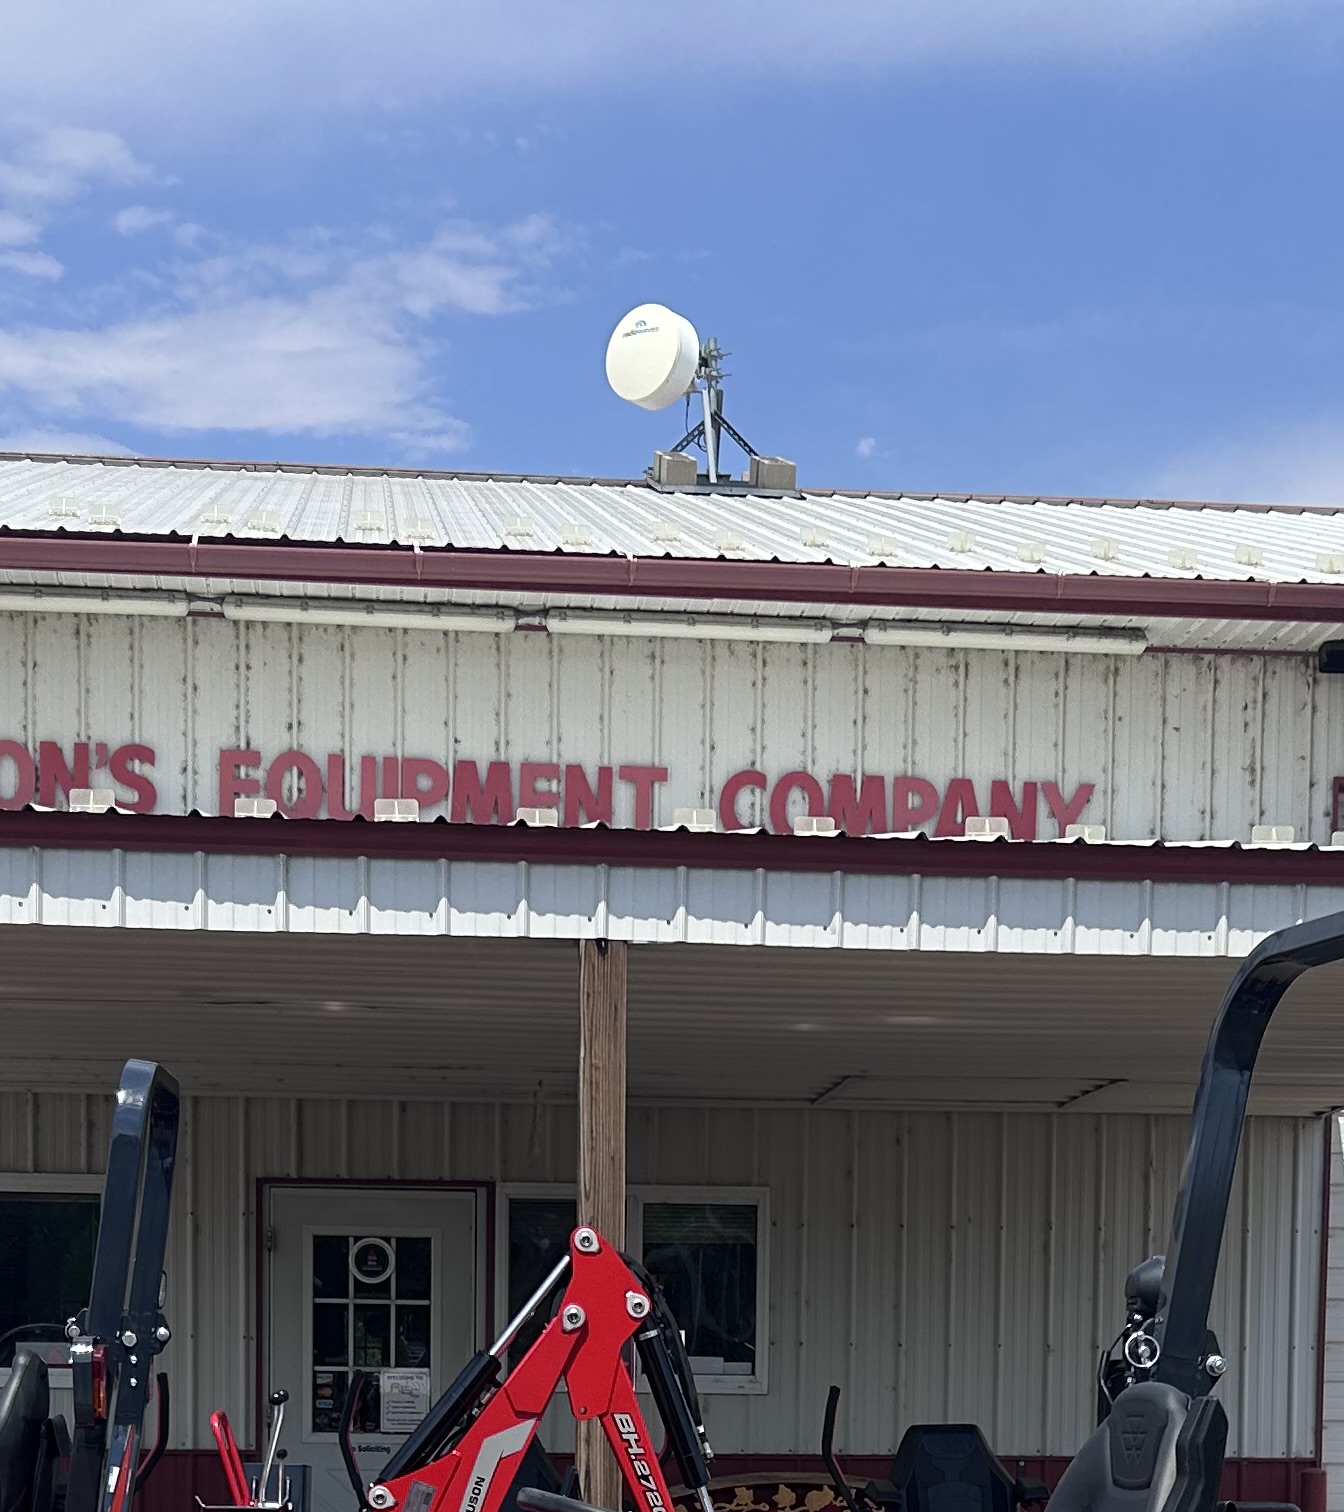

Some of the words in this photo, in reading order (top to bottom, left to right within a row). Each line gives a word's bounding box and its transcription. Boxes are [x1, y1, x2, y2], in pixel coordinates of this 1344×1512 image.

[219, 748, 668, 829] EQUIPMENT
[719, 769, 1095, 841] COMPANY
[357, 1445, 391, 1454] Soliciting
